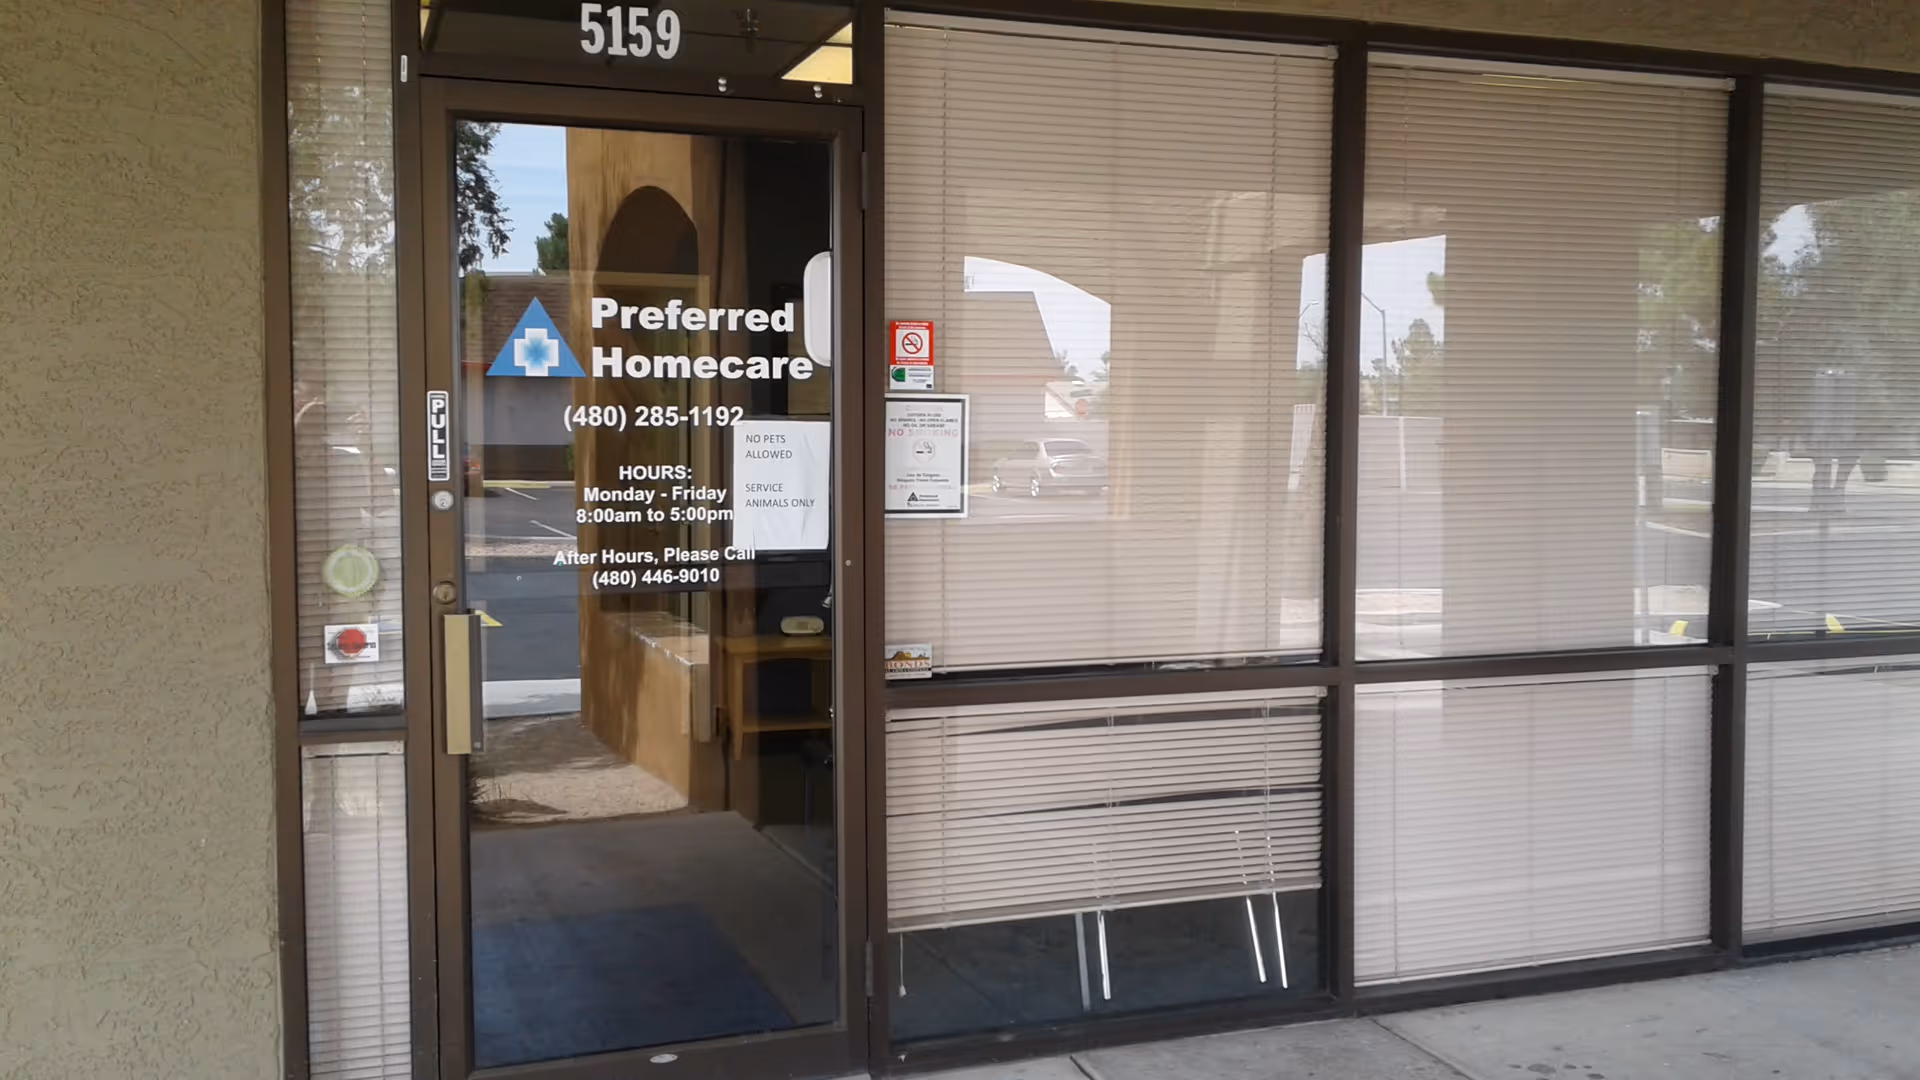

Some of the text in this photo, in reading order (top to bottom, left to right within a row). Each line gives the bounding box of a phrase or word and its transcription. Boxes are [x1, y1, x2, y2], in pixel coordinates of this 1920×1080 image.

[581, 2, 681, 60] 5159
[591, 297, 795, 332] Preferred
[592, 346, 814, 380] Homecare
[563, 405, 744, 432] (480) 285-1192
[431, 399, 446, 459] PULL
[888, 428, 904, 437] NO
[745, 434, 786, 444] NO PETS
[745, 449, 793, 459] ALLOWED
[619, 465, 692, 480] HOURS:
[583, 486, 655, 504] Monday
[671, 486, 727, 503] Friday
[745, 483, 784, 493] SERVICE
[745, 498, 815, 508] ANIMALS ONLY
[576, 507, 734, 524] 8:00am to 5:00pm
[553, 545, 756, 566] After Hours, Please Call
[592, 568, 720, 589] (480) 446-9010
